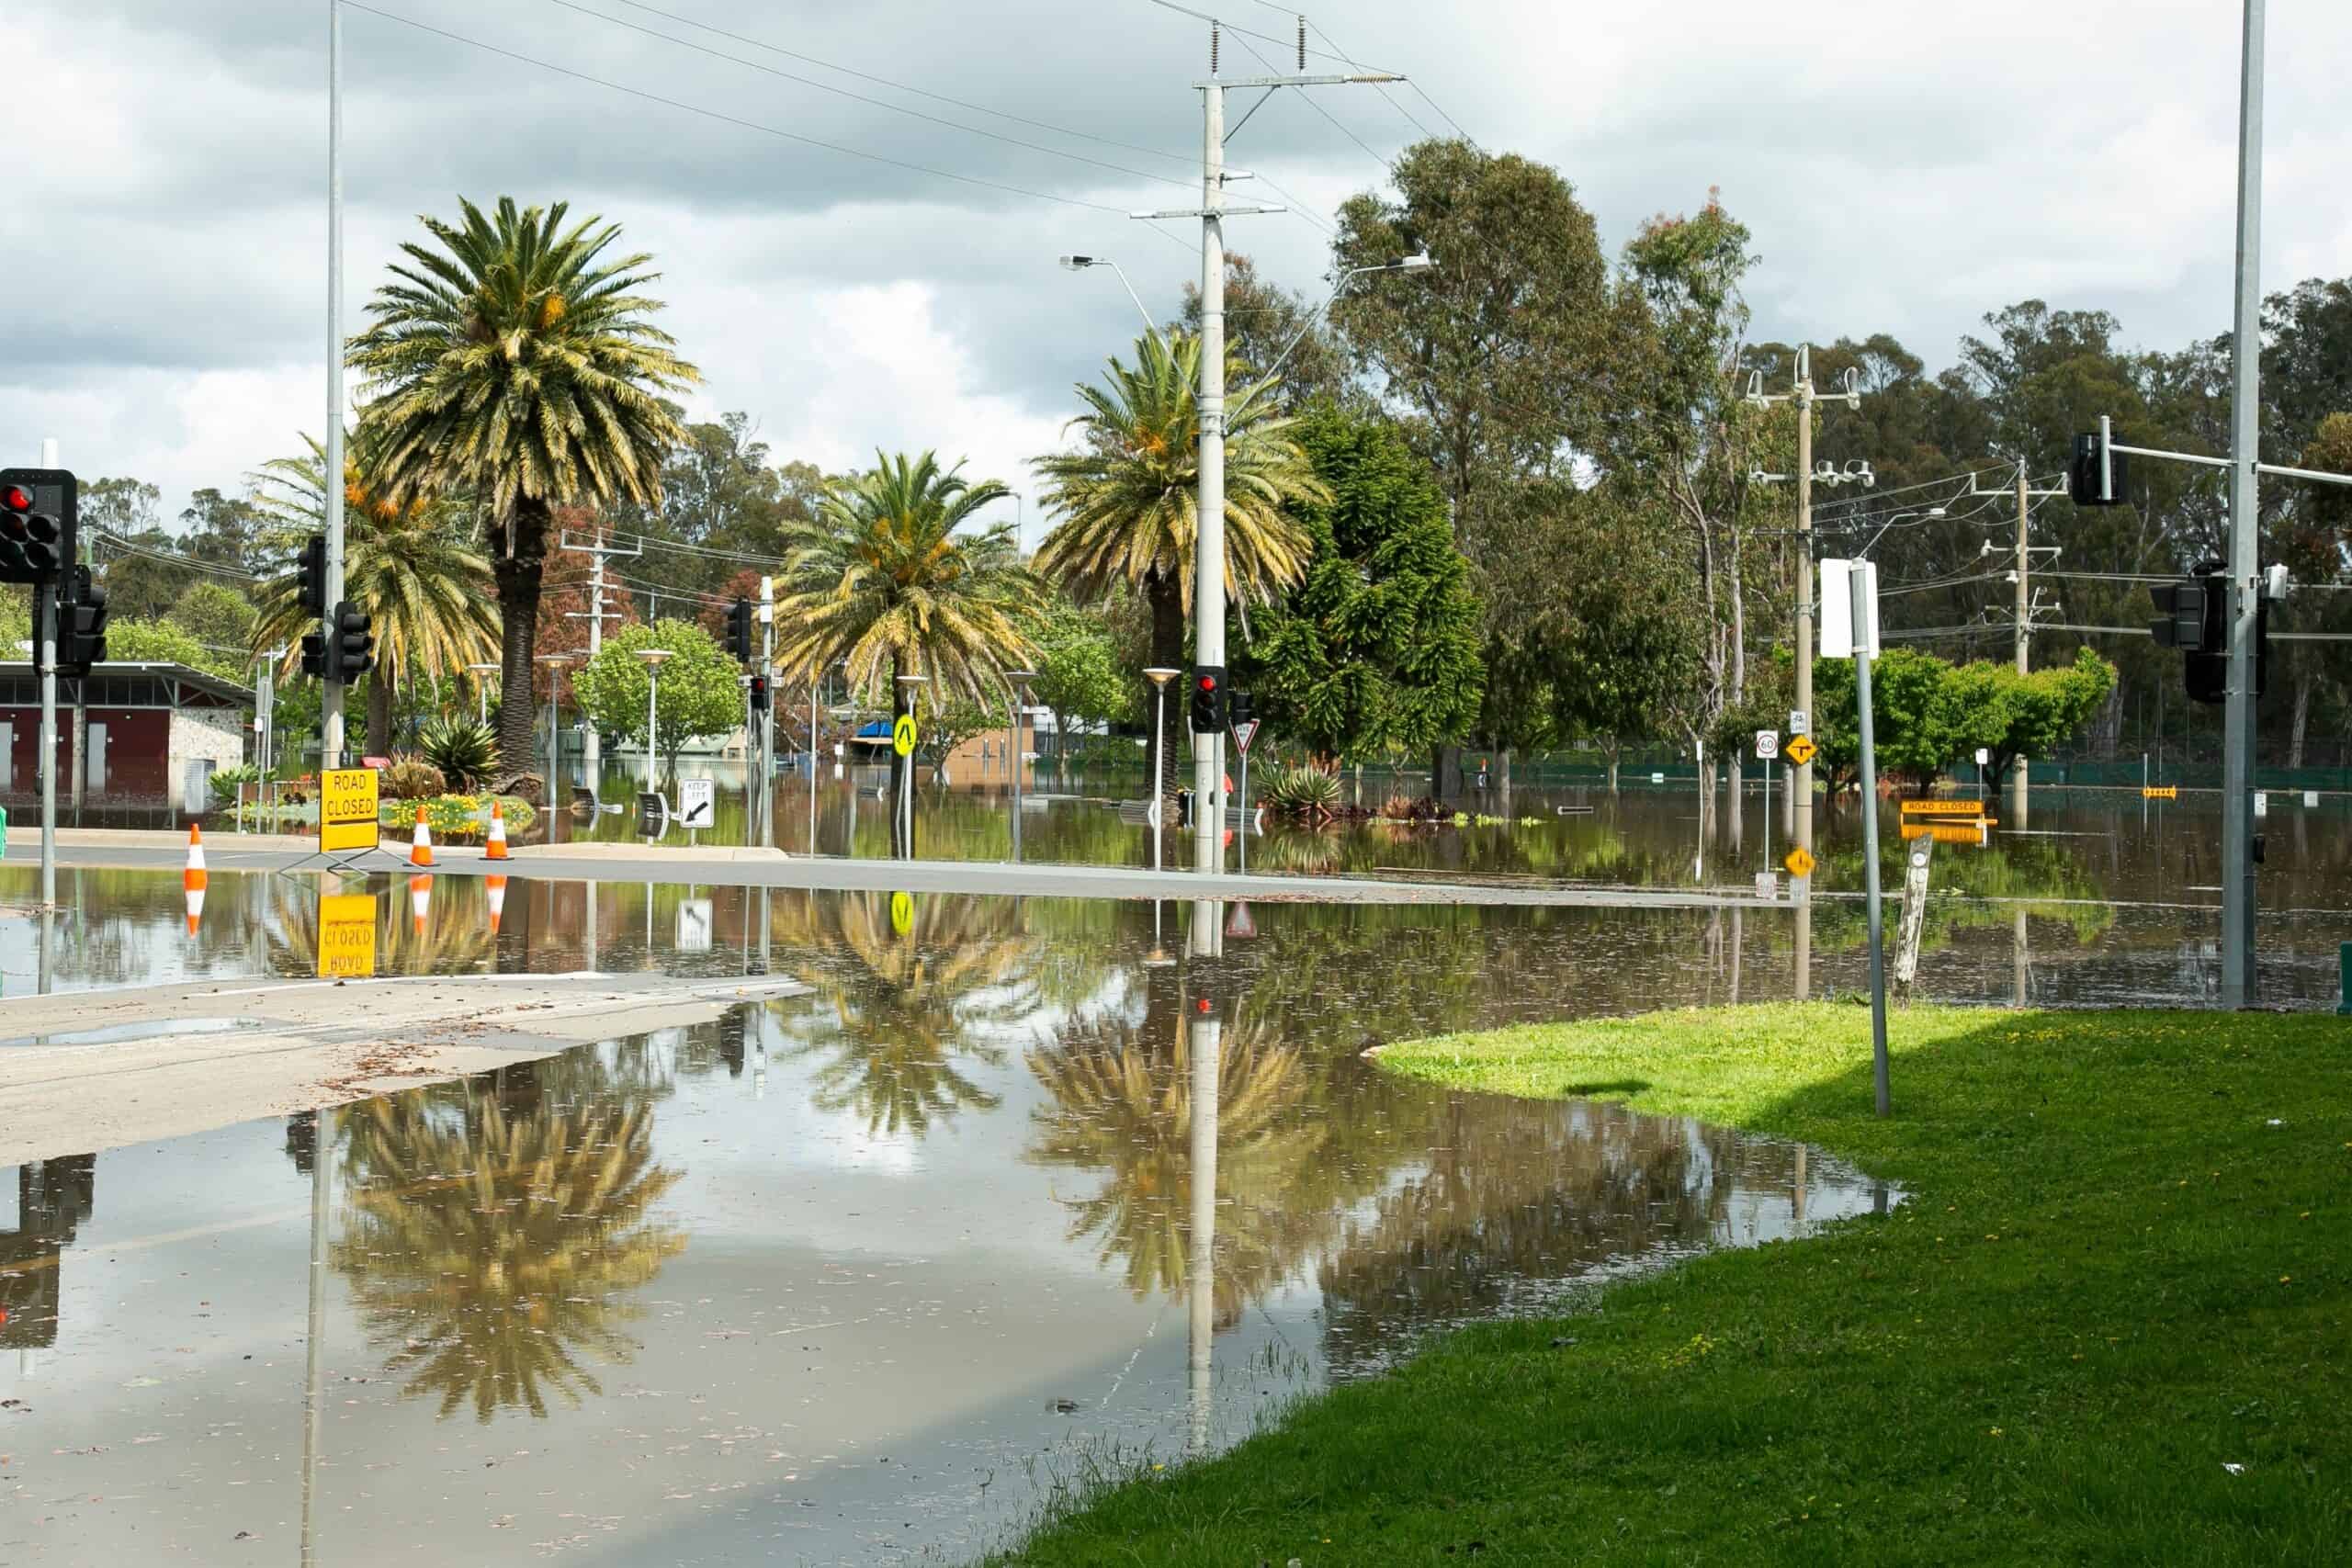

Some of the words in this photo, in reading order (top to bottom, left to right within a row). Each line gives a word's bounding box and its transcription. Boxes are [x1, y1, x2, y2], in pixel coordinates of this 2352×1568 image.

[1760, 739, 1773, 750] 60
[334, 773, 367, 792] ROAD
[687, 782, 707, 790] KEEP
[327, 797, 374, 817] CLOSED
[1908, 801, 1935, 810] ROAD
[1939, 801, 1976, 810] CLOSED
